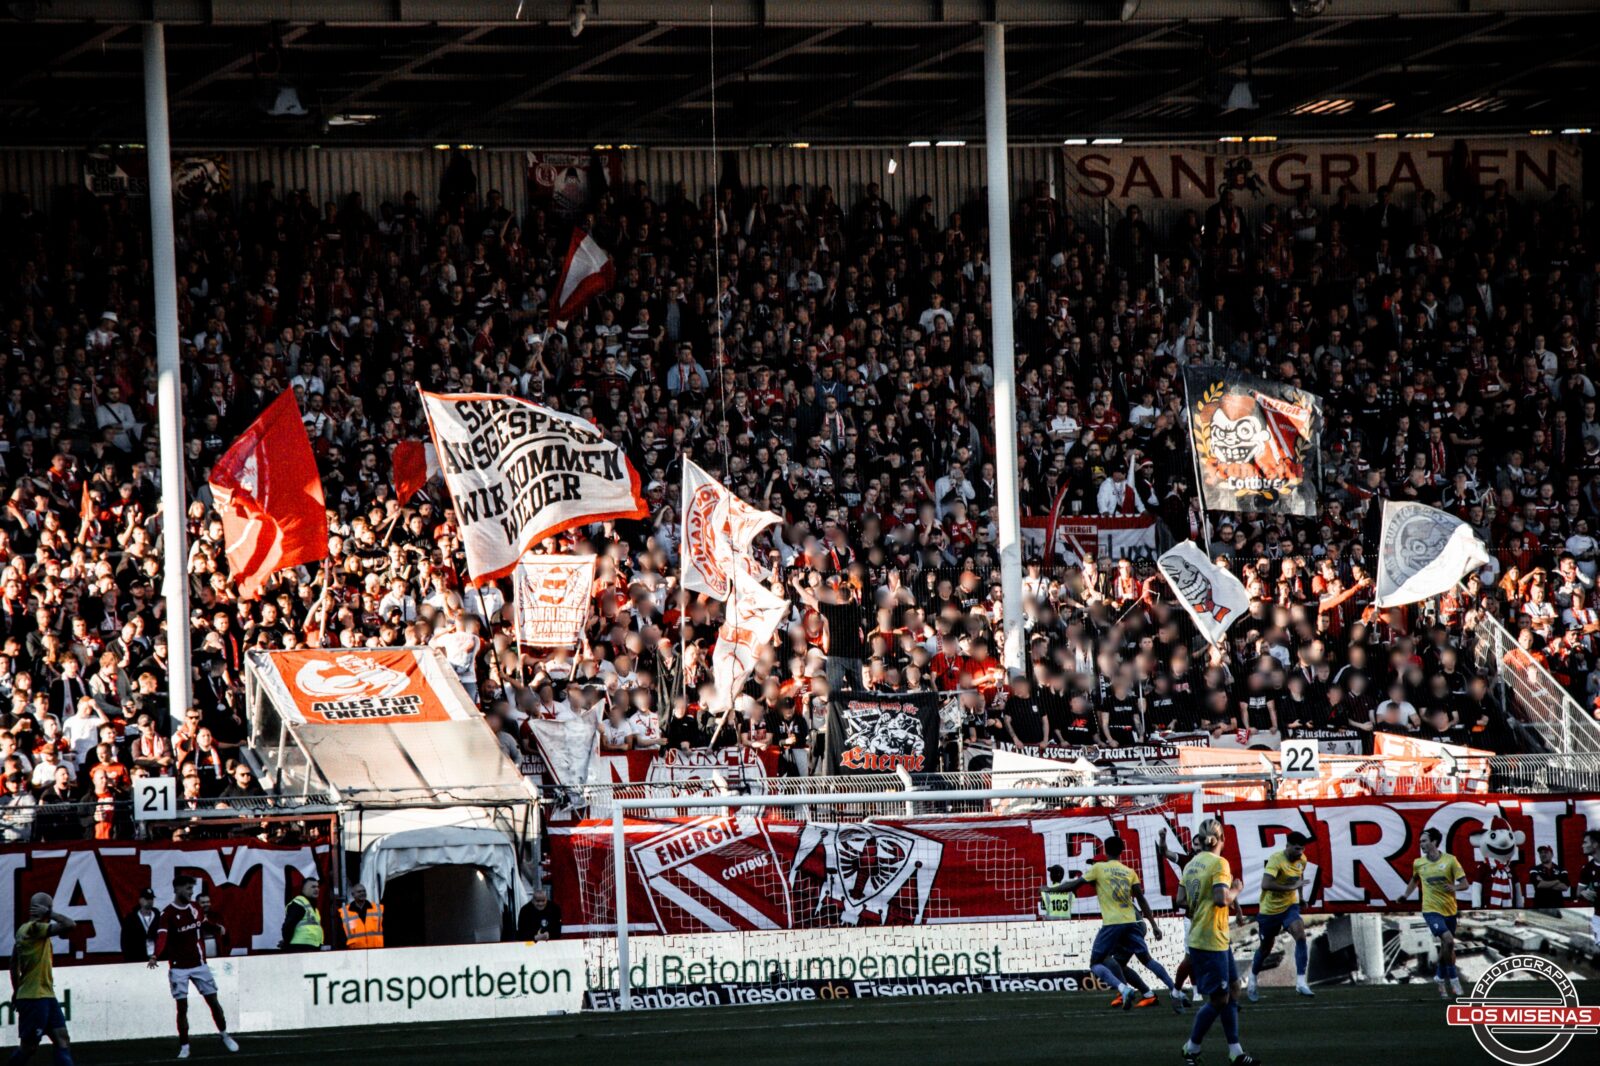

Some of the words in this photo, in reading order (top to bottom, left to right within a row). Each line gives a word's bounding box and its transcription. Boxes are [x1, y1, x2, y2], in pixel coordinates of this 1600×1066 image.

[1076, 152, 1215, 199] SAN
[455, 482, 508, 527] WIR
[505, 445, 624, 500] KOMMEN
[1064, 526, 1093, 534] ENERGIE
[313, 698, 373, 712] ALLES
[378, 695, 421, 706] FÜR
[324, 704, 418, 720] ENERGIE!
[1287, 747, 1315, 772] 22
[143, 786, 170, 812] 21
[654, 815, 744, 867] ENERGIE
[721, 853, 769, 882] COTTBUS
[1031, 800, 1600, 915] ENERGI
[1051, 899, 1069, 912] 103
[303, 963, 572, 1008] Transportbeton
